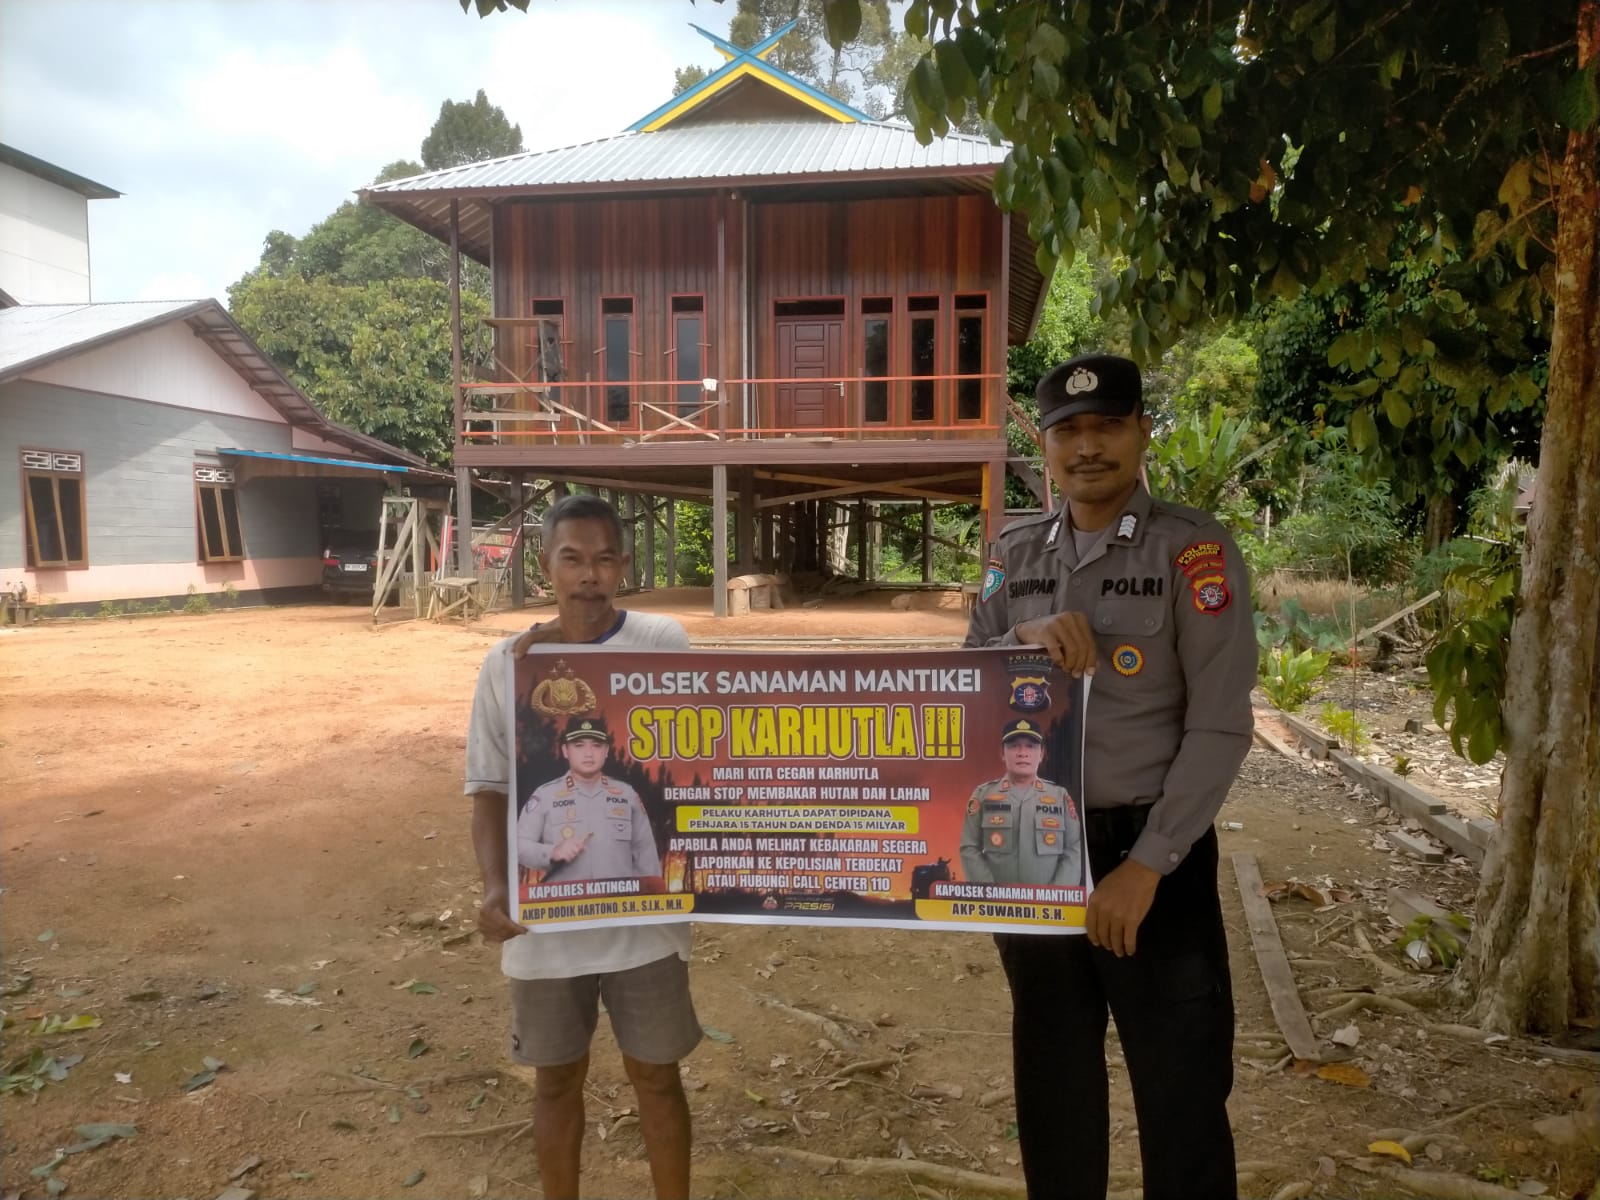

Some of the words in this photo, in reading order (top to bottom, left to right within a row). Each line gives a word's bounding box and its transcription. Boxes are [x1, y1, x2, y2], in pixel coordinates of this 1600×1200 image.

[1178, 543, 1221, 564] POLRES
[1101, 577, 1163, 596] POLRI
[610, 672, 710, 695] POLSEK
[716, 670, 846, 694] SANAMAN
[855, 668, 981, 692] MANTIKEI
[629, 706, 724, 760] STOP
[730, 705, 918, 758] KARHUTLA
[713, 768, 744, 780] MARI
[748, 768, 773, 780] KITA
[777, 767, 814, 780] CEGAH
[819, 767, 879, 780] KARHUTLA
[664, 787, 710, 800] DENGAN
[714, 787, 743, 800] STOP
[748, 787, 816, 800] MEMBAKAR
[821, 787, 858, 800] HUTAN
[863, 787, 886, 800] DAN
[891, 787, 930, 801] LAHAN
[702, 809, 742, 818] PELAKU
[744, 809, 800, 818] KARHUTLA
[803, 809, 837, 818] DAPAT
[839, 809, 891, 818] DIPIDANA
[1036, 805, 1063, 814] POLRI
[690, 820, 738, 829] PENJARA
[752, 821, 787, 829] TAHUN
[790, 821, 812, 829] DAN
[815, 821, 851, 830] DENDA
[853, 821, 863, 829] 15
[866, 821, 905, 830] MILYAR
[670, 838, 718, 851] APABILA
[721, 838, 753, 851] ANDA
[756, 838, 806, 852] MELIHAT
[810, 839, 878, 853] KEBAKARAN
[882, 840, 927, 854] SEGERA
[694, 857, 754, 869] LAPORKAN
[758, 857, 772, 869] KE
[775, 857, 841, 870] KEPOLISIAN
[845, 858, 903, 872] TERDEKAT
[528, 883, 584, 899] KAPOLRES
[586, 880, 640, 895] KATINGAN
[707, 875, 736, 887] ATAU
[739, 875, 789, 888] HUBUNGI
[793, 875, 821, 889] CALL
[824, 876, 867, 890] CENTER
[871, 878, 891, 891] 110
[935, 885, 984, 898] KAPOLSEK
[986, 886, 1034, 900] SANAMAN
[1035, 889, 1083, 902] MANTIKEI
[522, 908, 546, 921] AKBP
[549, 905, 576, 919] DODIK
[784, 902, 835, 911] PRESISI
[952, 903, 976, 916] AKP
[978, 904, 1039, 919] SUWARDI,
[1042, 907, 1065, 921] S.H.
